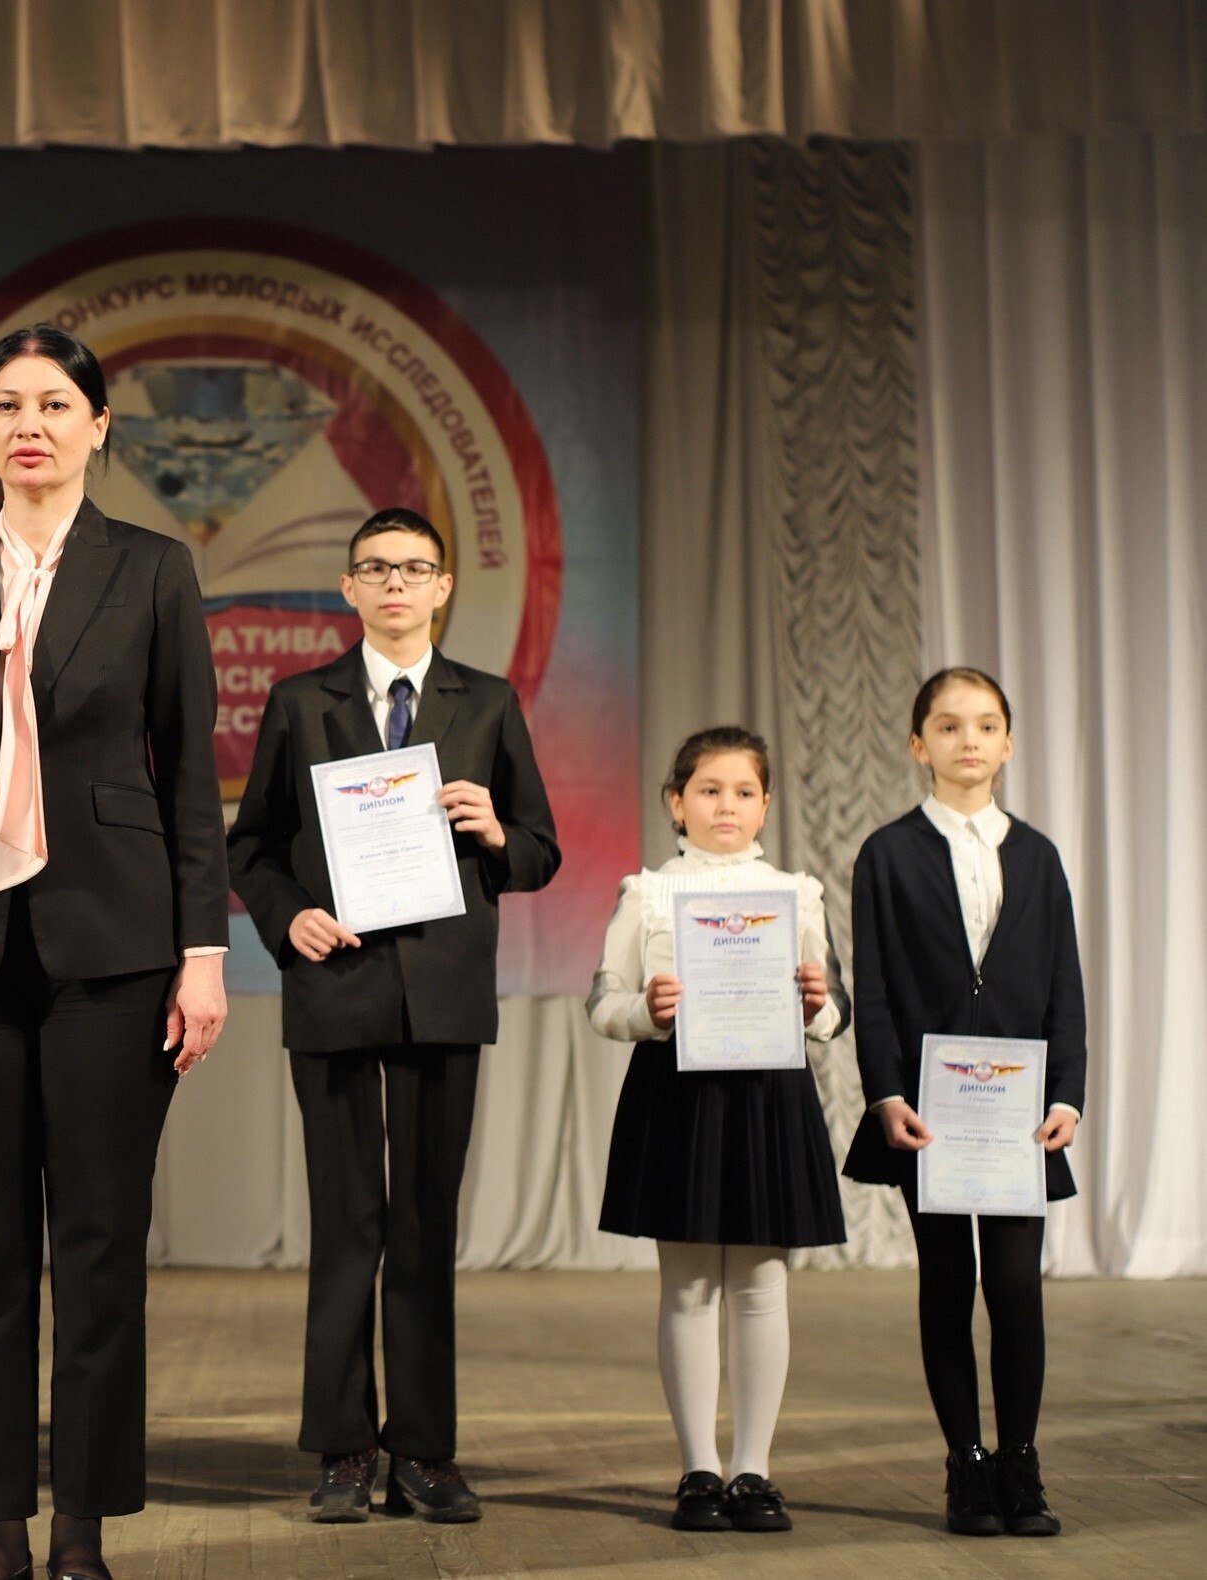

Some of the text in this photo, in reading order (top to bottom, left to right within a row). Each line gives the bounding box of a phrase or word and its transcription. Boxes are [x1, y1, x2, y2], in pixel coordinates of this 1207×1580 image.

[48, 273, 177, 334] ОНКУРС
[185, 271, 348, 325] МОЛОДЫХ
[350, 313, 508, 570] ИССЛЕДОВАТЕЛЕЙ
[214, 704, 266, 735] ЕС
[358, 795, 405, 812] ДИПЛОМ
[713, 936, 761, 947] ДИПЛОМ
[959, 1083, 1006, 1094] ДИПЛОМ
